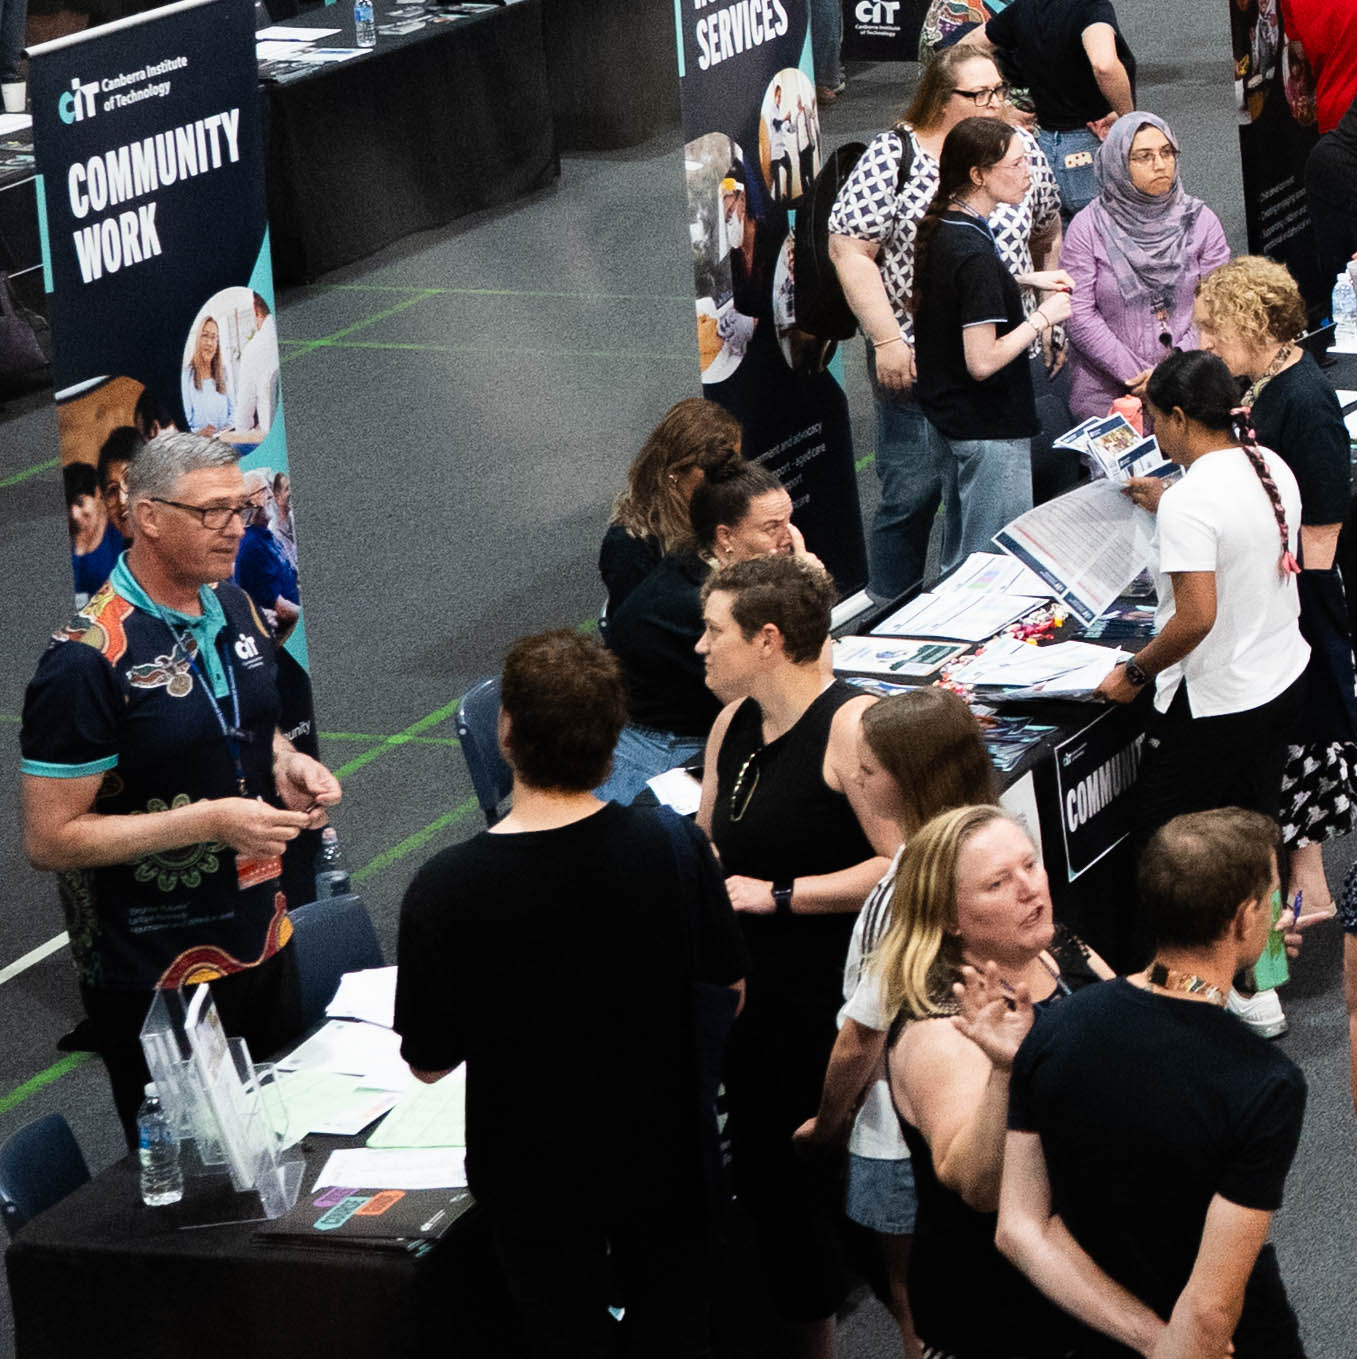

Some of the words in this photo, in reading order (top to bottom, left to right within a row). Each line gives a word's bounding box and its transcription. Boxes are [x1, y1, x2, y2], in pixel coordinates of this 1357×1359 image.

[101, 68, 146, 92] Canberra
[146, 56, 188, 78] Institute
[103, 97, 116, 112] of
[115, 81, 172, 108] Technology
[68, 108, 240, 218] COMMUNITY
[72, 202, 162, 284] WORK
